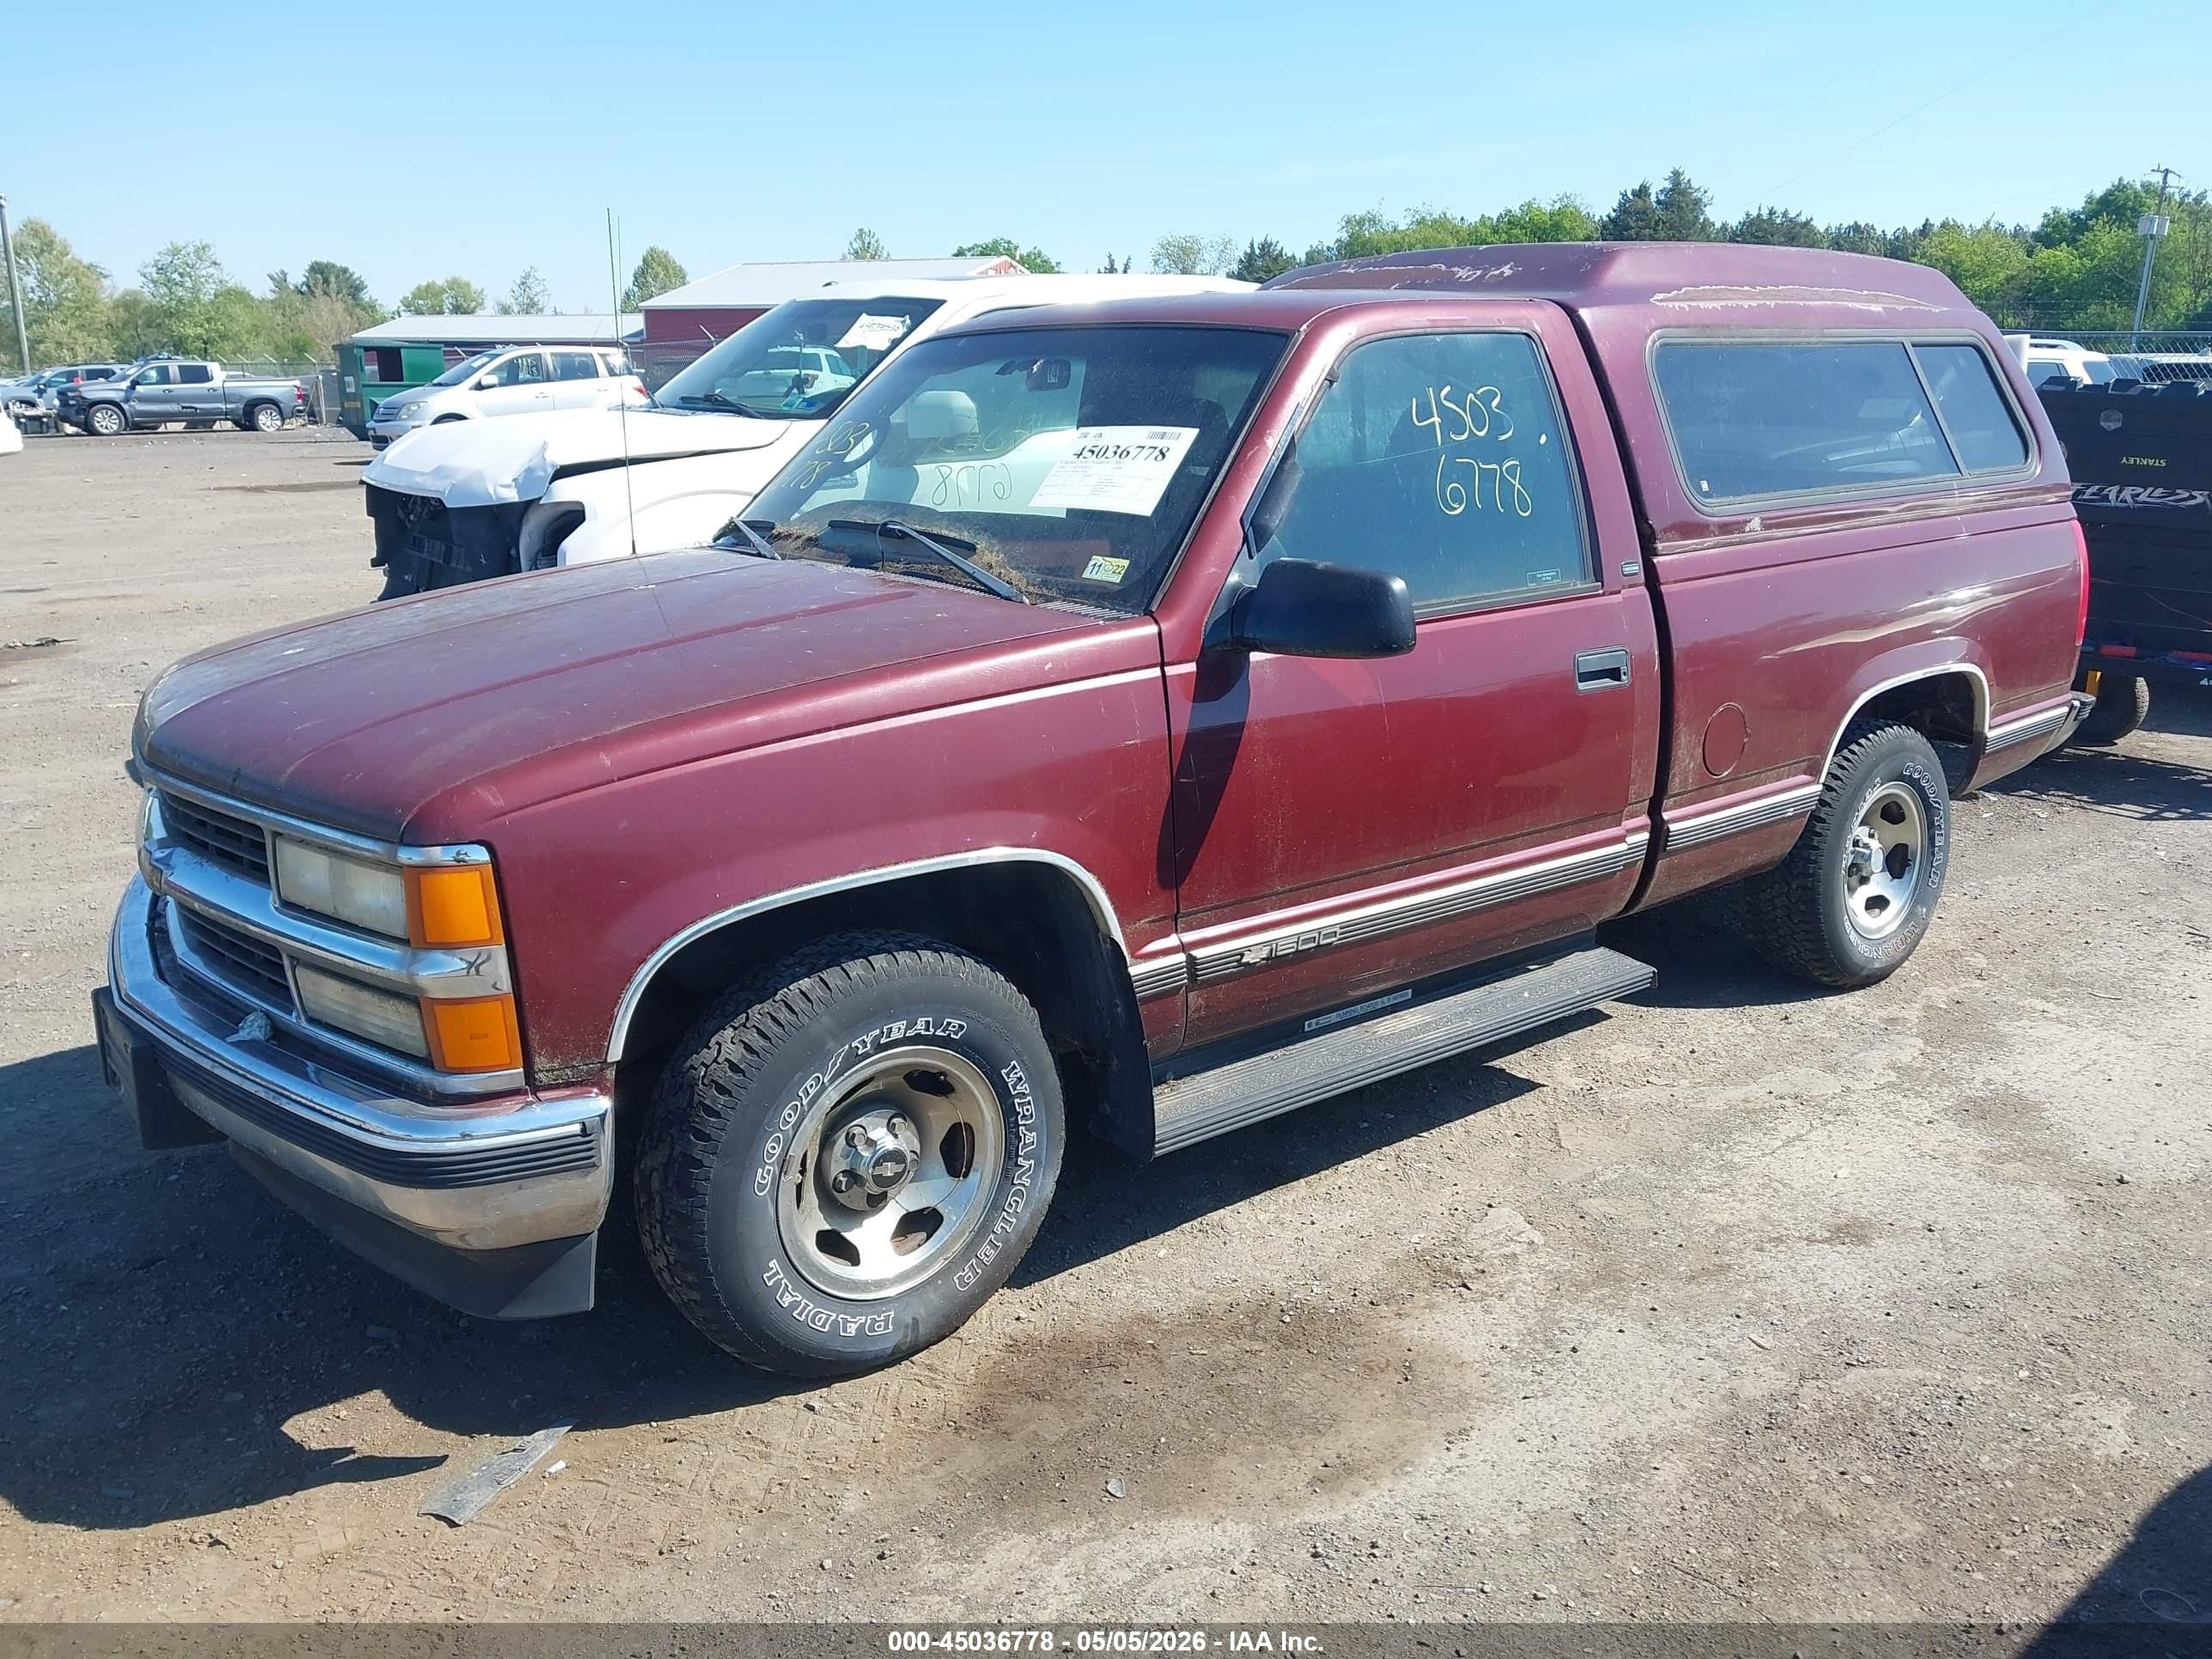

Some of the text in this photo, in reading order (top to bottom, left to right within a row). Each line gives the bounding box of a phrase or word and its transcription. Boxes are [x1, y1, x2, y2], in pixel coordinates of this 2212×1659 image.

[1412, 385, 1514, 447] 4503
[1073, 443, 1170, 462] 45036778
[2120, 455, 2167, 467] STANLEY
[1436, 454, 1532, 517] 6778
[1090, 562, 1126, 575] 11 22
[1271, 927, 1340, 957] 1500
[952, 1060, 1037, 1291] WRANGLER
[762, 1259, 895, 1337] RADIAL
